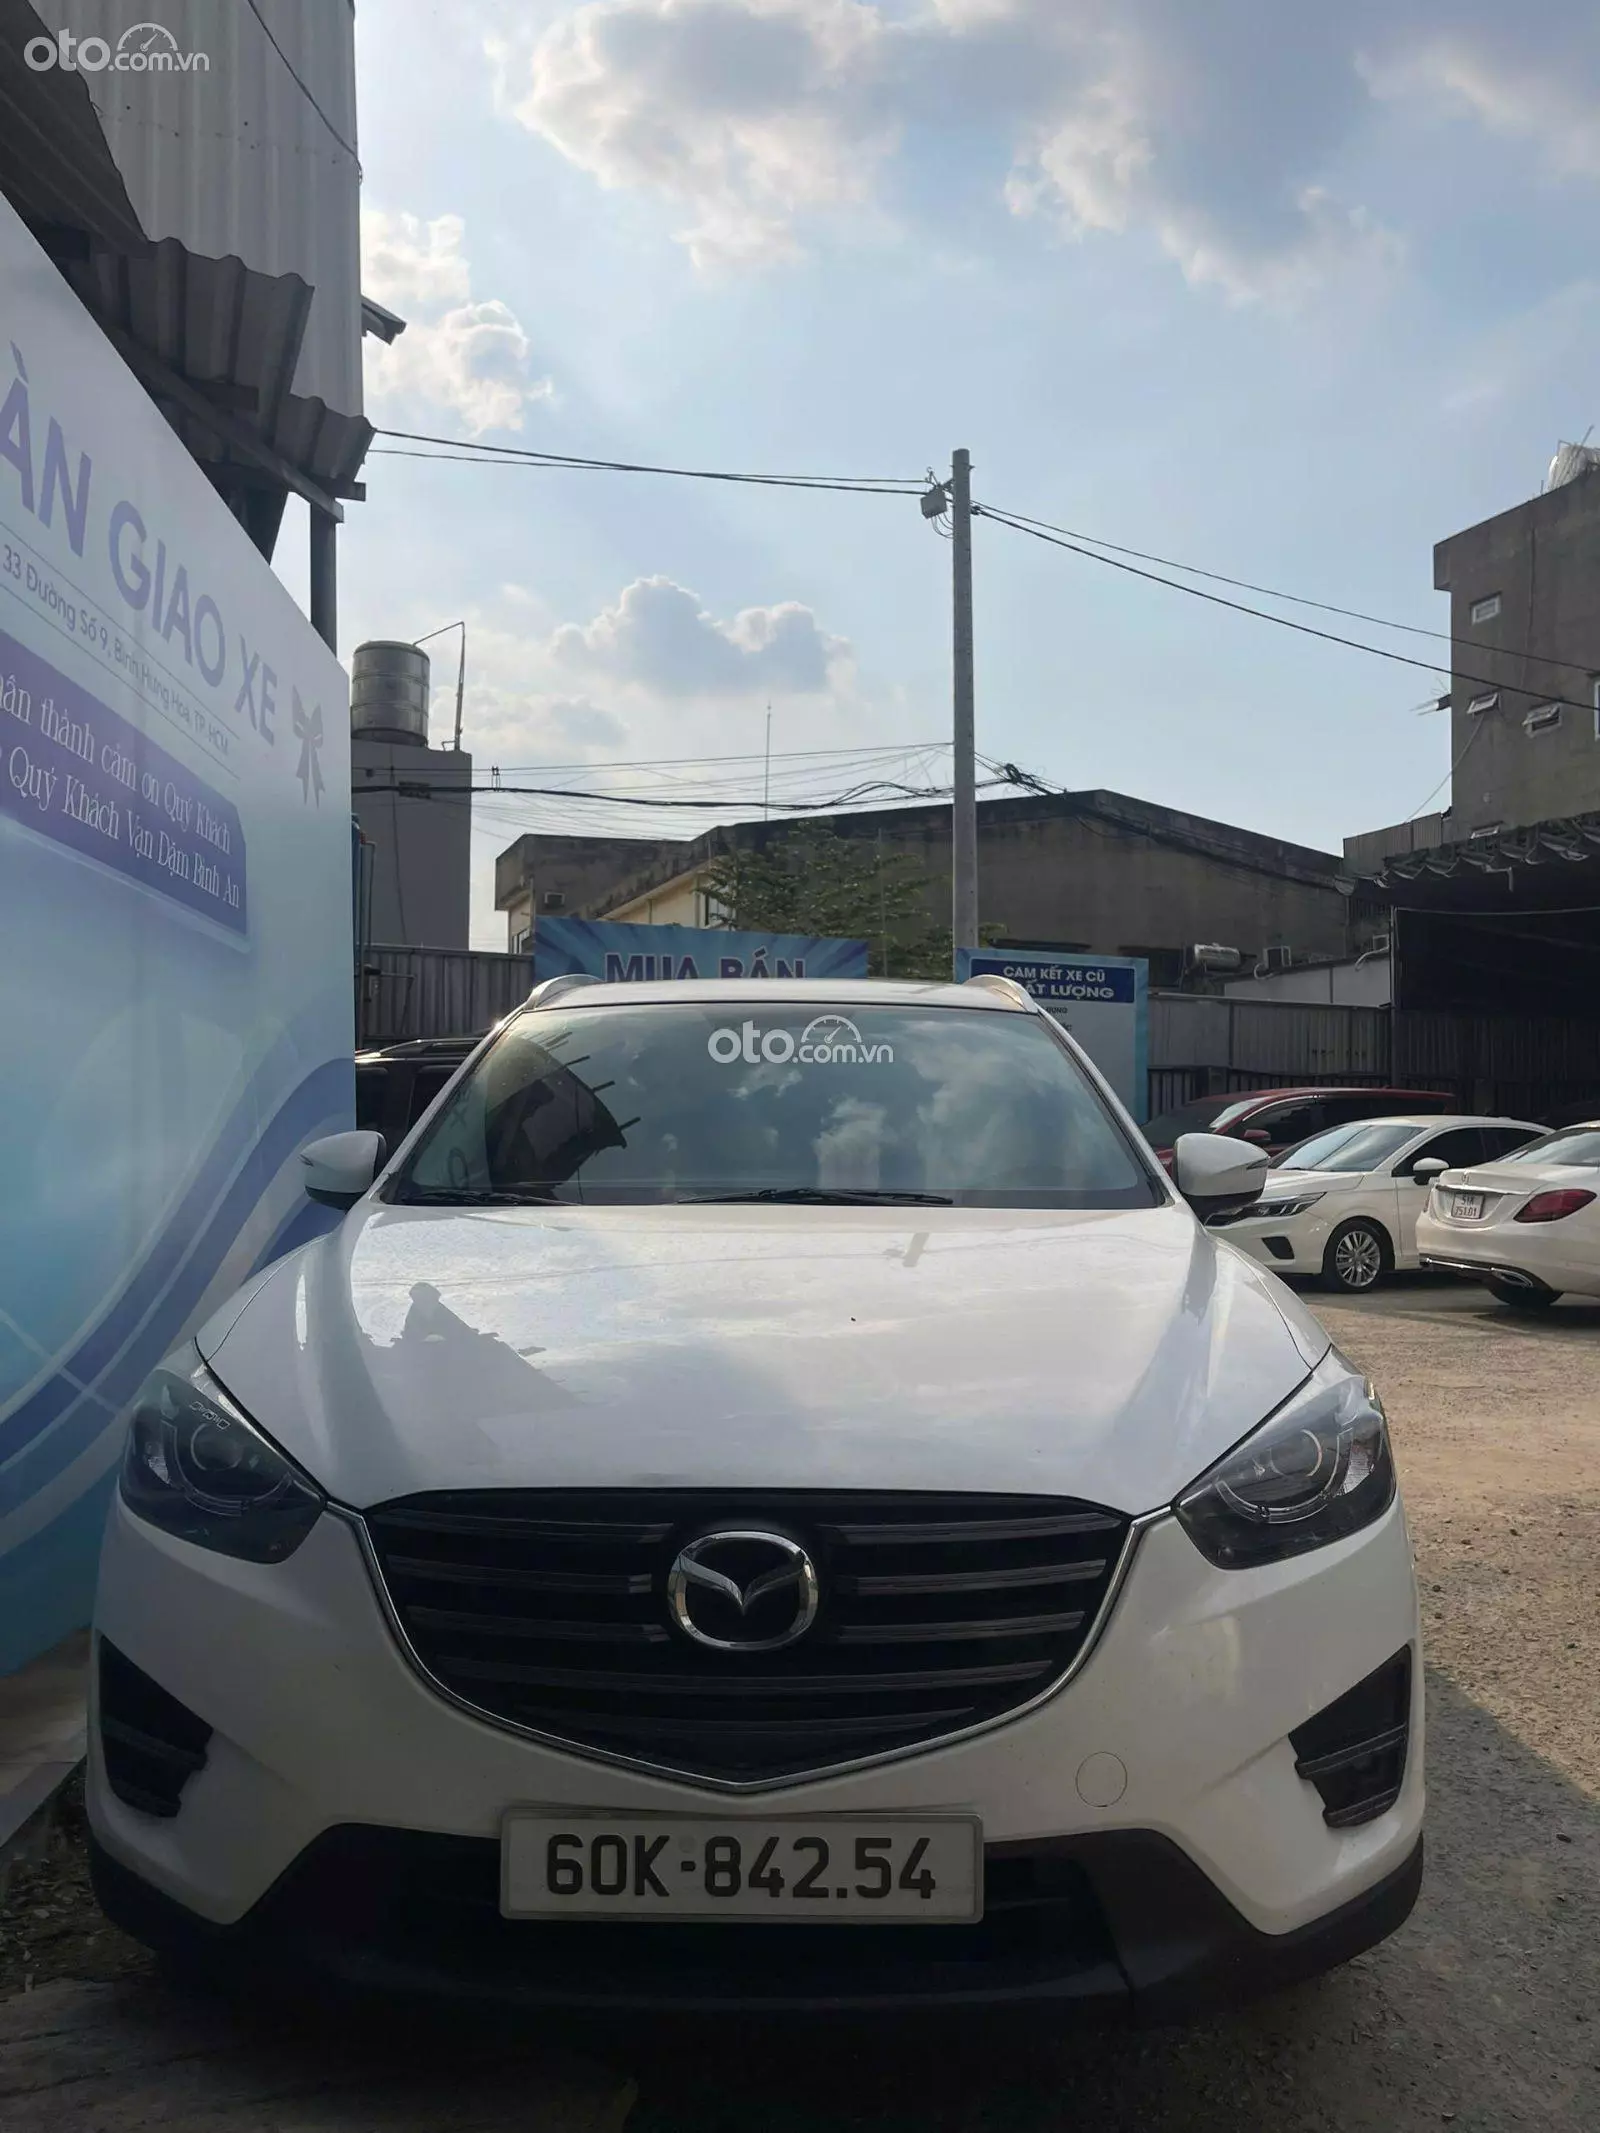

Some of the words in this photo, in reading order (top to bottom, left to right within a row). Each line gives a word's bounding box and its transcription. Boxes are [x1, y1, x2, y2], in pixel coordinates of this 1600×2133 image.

[2, 543, 22, 580] 33
[108, 500, 226, 688] GIAO
[234, 633, 278, 748] XE
[0, 674, 31, 726] ân
[9, 746, 58, 812] Quý
[62, 773, 120, 840] Khách
[222, 864, 240, 909] An
[1003, 965, 1037, 979] CAM
[1040, 965, 1064, 980] KẾT
[1066, 971, 1083, 981] XE
[1085, 969, 1106, 983] CŨ
[546, 1833, 937, 1898] 60K-842.54
